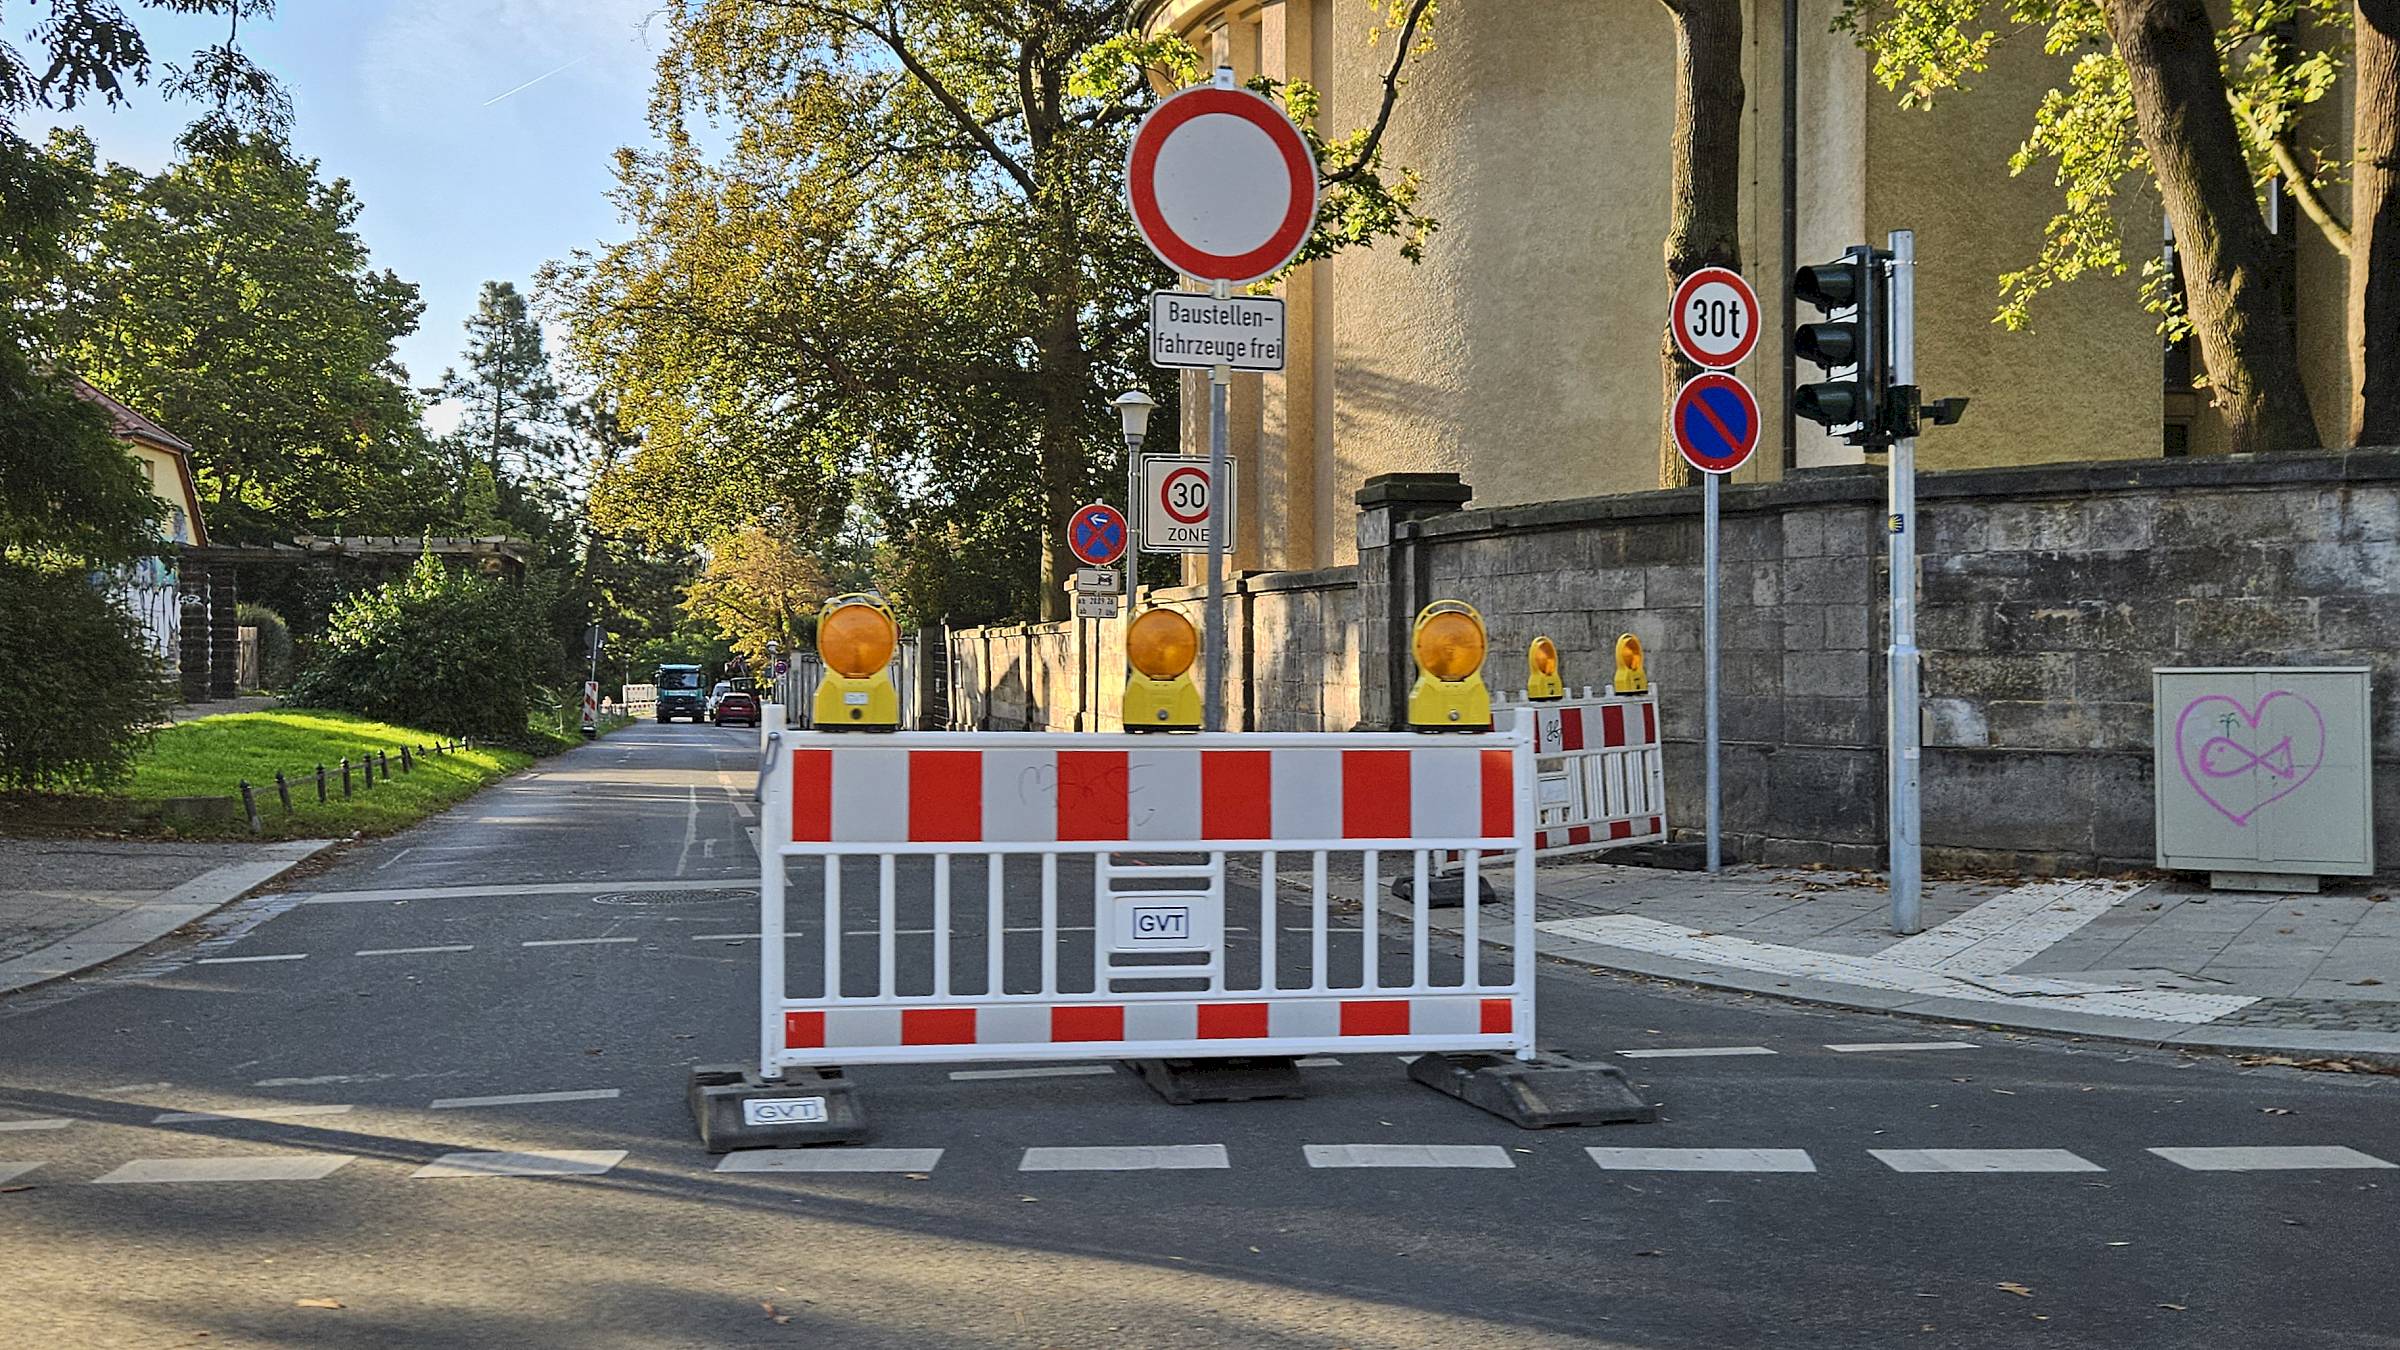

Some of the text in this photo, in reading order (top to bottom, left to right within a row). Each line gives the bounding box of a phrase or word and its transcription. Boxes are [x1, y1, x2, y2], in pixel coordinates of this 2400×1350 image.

[1169, 301, 1274, 327] Baustellen-
[1693, 299, 1740, 339] 30t
[1156, 332, 1281, 362] fahrzeuge frei
[1173, 483, 1205, 508] 30
[1168, 528, 1210, 542] ZONE
[1140, 915, 1184, 932] GVT
[756, 1104, 815, 1118] GVT
